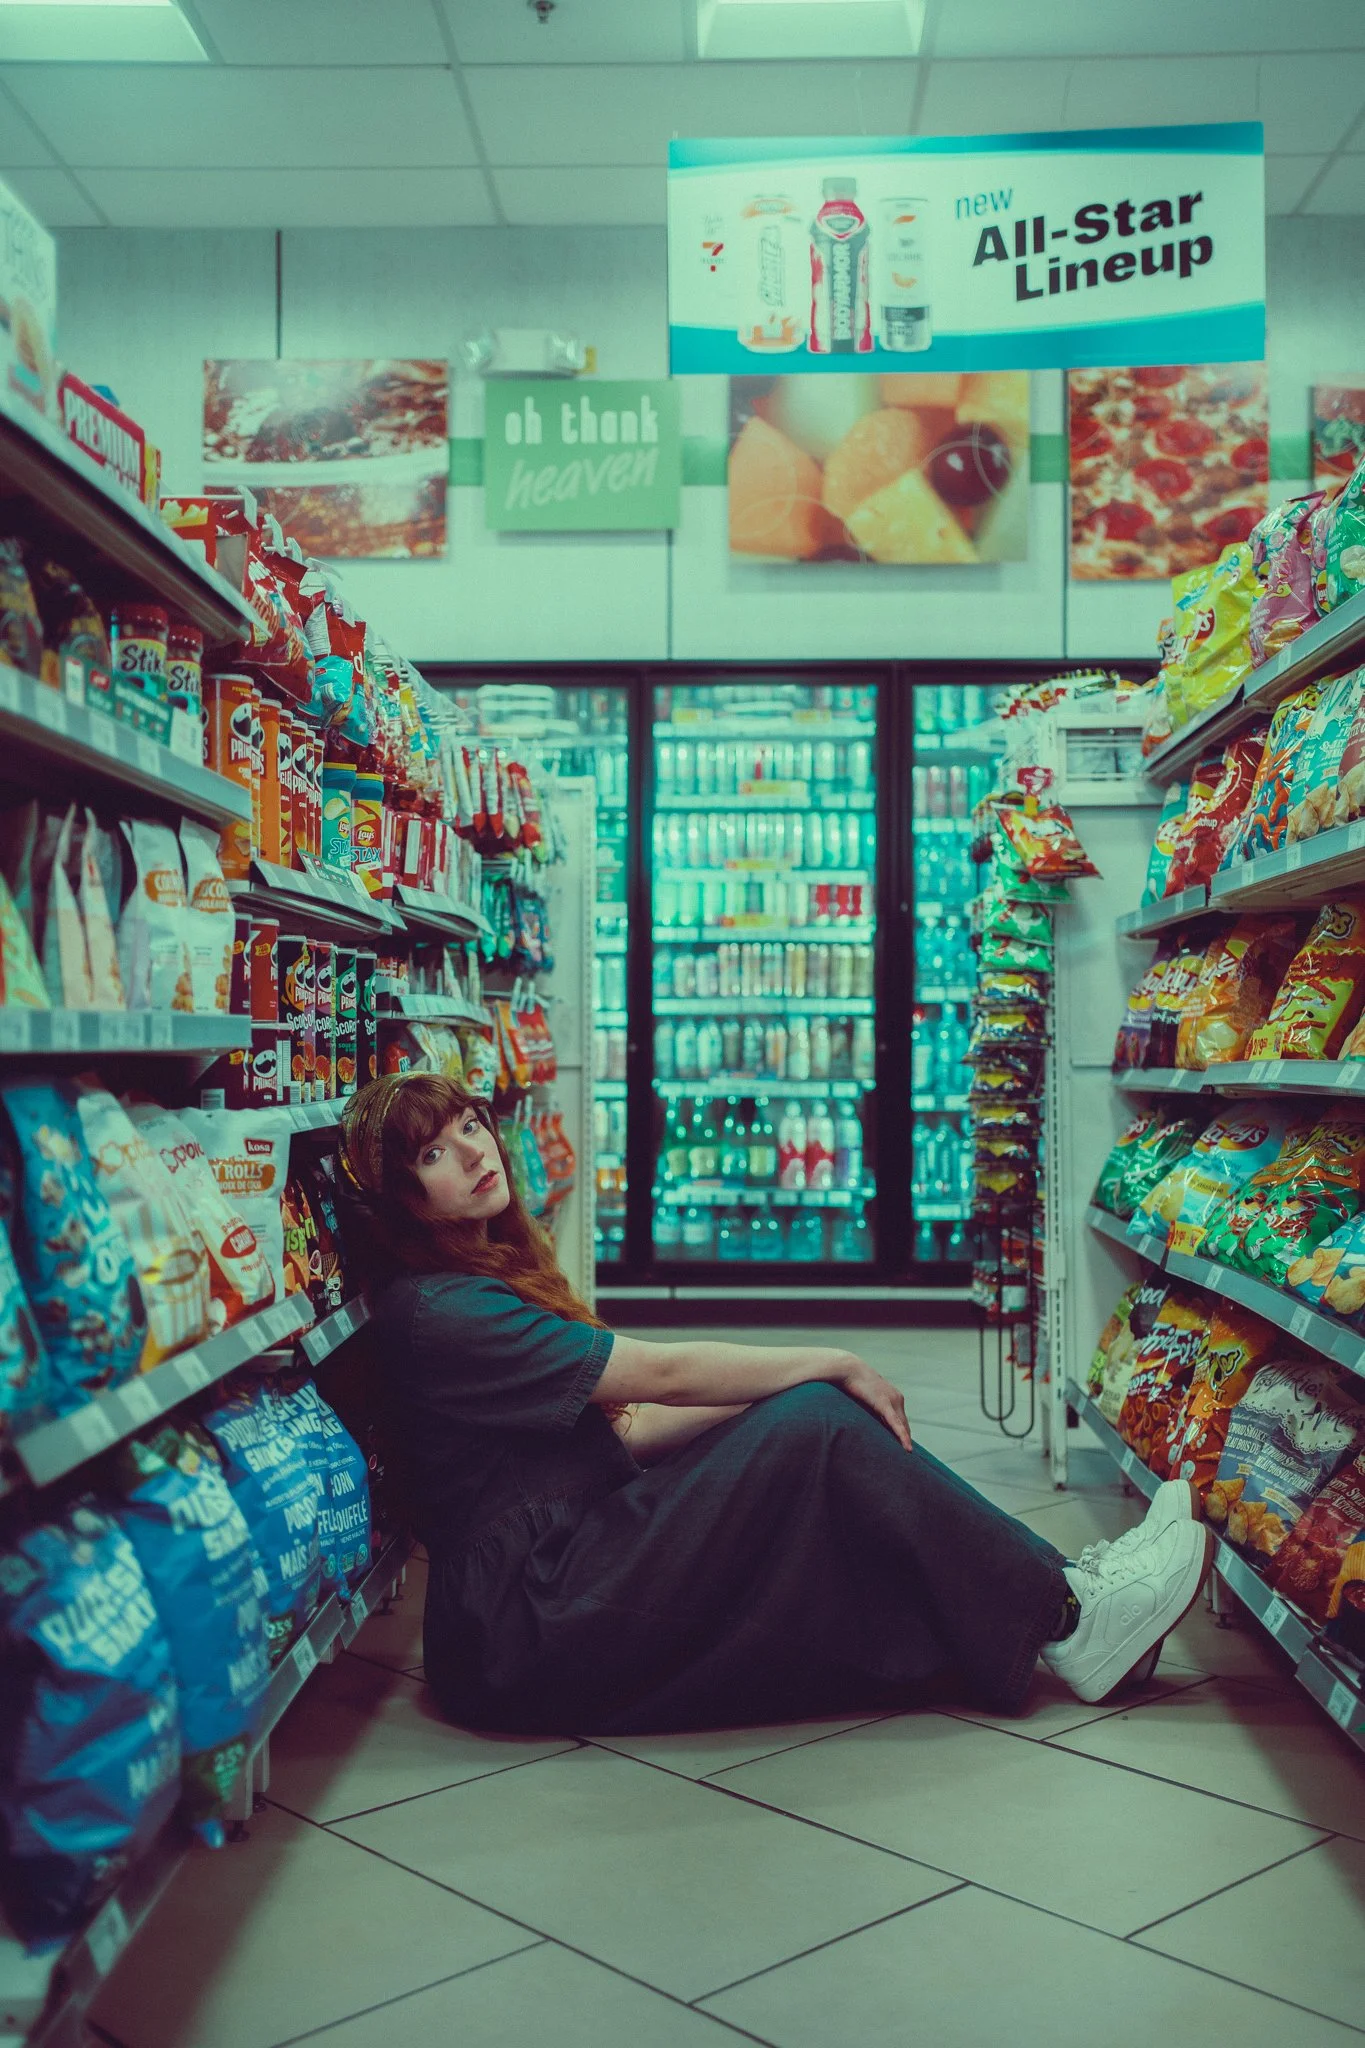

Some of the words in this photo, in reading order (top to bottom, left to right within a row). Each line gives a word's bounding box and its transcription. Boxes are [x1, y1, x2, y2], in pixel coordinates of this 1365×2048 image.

[955, 187, 1014, 221] new
[973, 191, 1203, 267] All-Star
[1015, 235, 1214, 302] Lineup
[64, 386, 141, 486] PREMIUM
[505, 396, 543, 444] oh
[561, 395, 659, 444] thank
[506, 448, 660, 510] heaven
[350, 845, 381, 863] STAX
[247, 1140, 271, 1152] kosa
[224, 1163, 263, 1180] ROLLS
[337, 1494, 368, 1533] OUFFLÉ
[1120, 1603, 1142, 1626] alo
